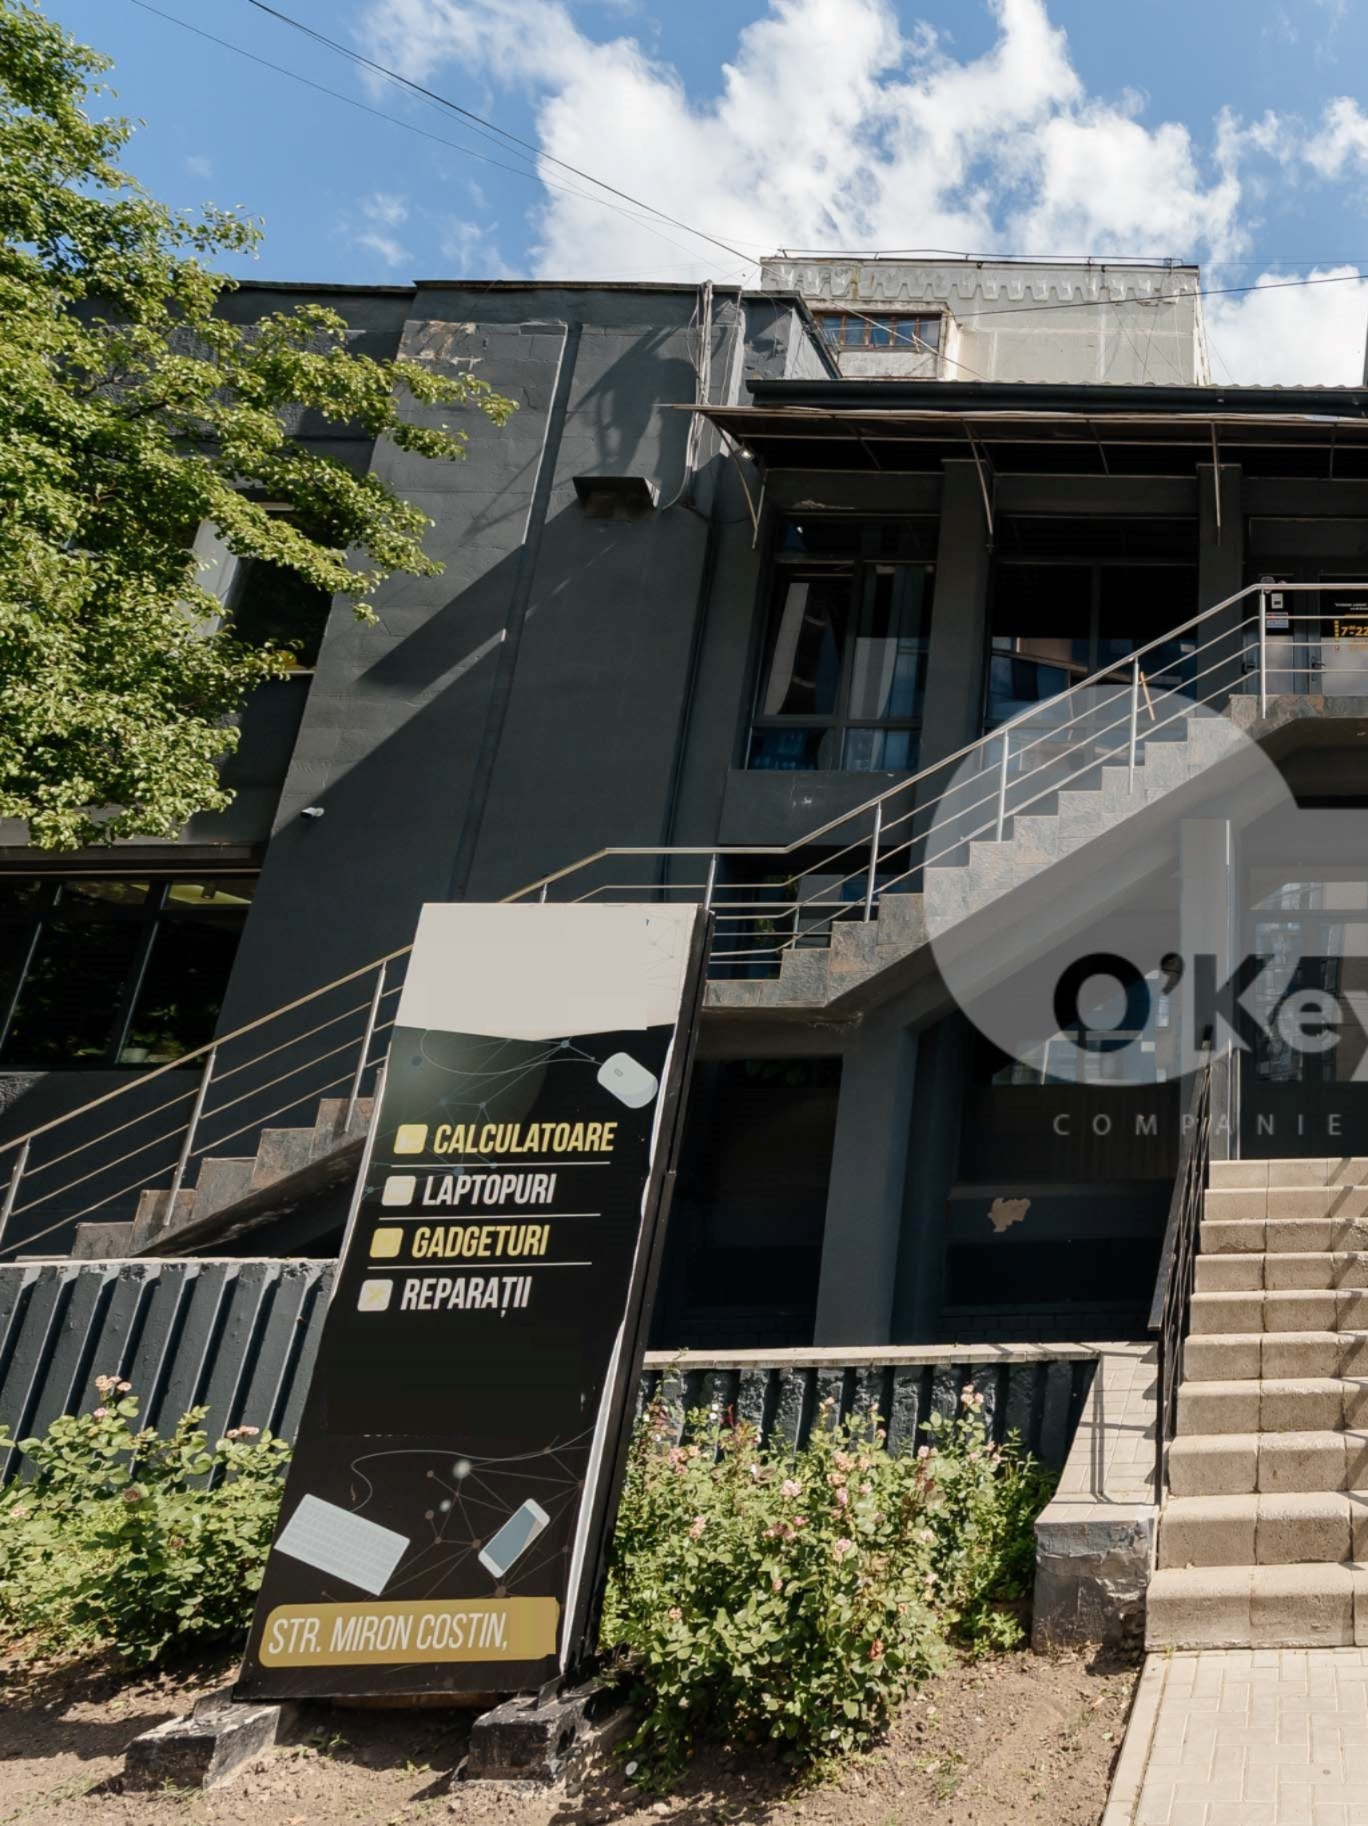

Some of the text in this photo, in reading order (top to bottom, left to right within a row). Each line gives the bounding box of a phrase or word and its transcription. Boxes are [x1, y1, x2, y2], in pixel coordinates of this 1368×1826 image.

[433, 1122, 618, 1153] CALCULATOARE
[422, 1173, 557, 1206] LAPTOPURI
[411, 1225, 550, 1258] GADGETURI
[400, 1276, 532, 1317] REPARAȚII
[268, 1612, 508, 1654] STR. MIRON COSTIN,
